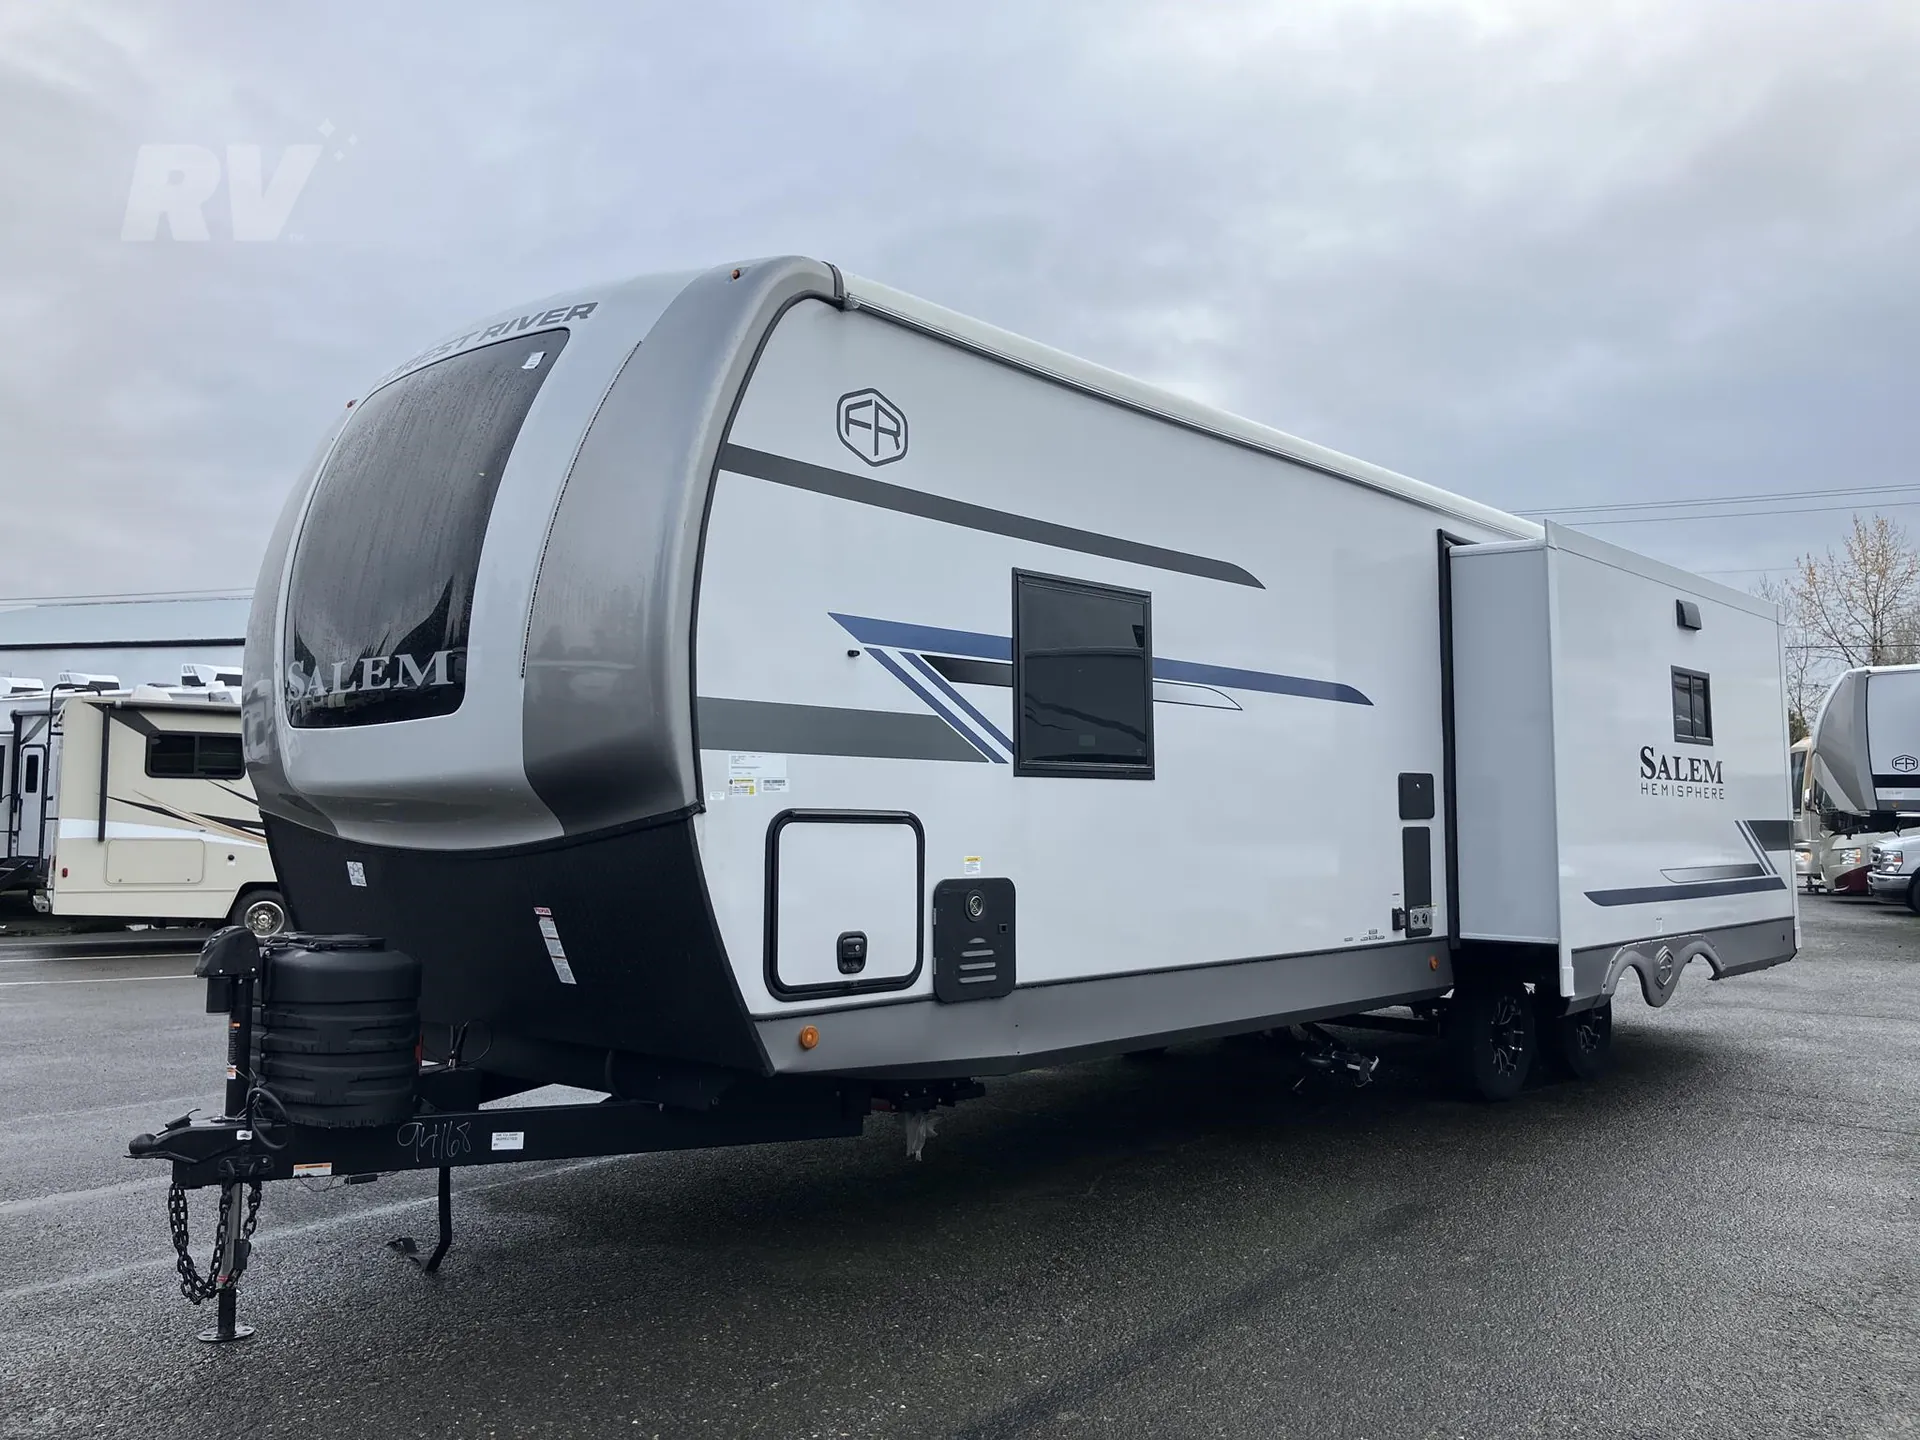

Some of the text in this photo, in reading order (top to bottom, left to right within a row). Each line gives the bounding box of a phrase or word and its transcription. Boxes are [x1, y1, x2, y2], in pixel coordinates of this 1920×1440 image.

[477, 302, 598, 342] RIVER
[287, 650, 454, 700] SALEM
[1640, 745, 1724, 784] SALEM
[1640, 783, 1725, 800] HEMISPHERE
[397, 1120, 471, 1163] 94168
